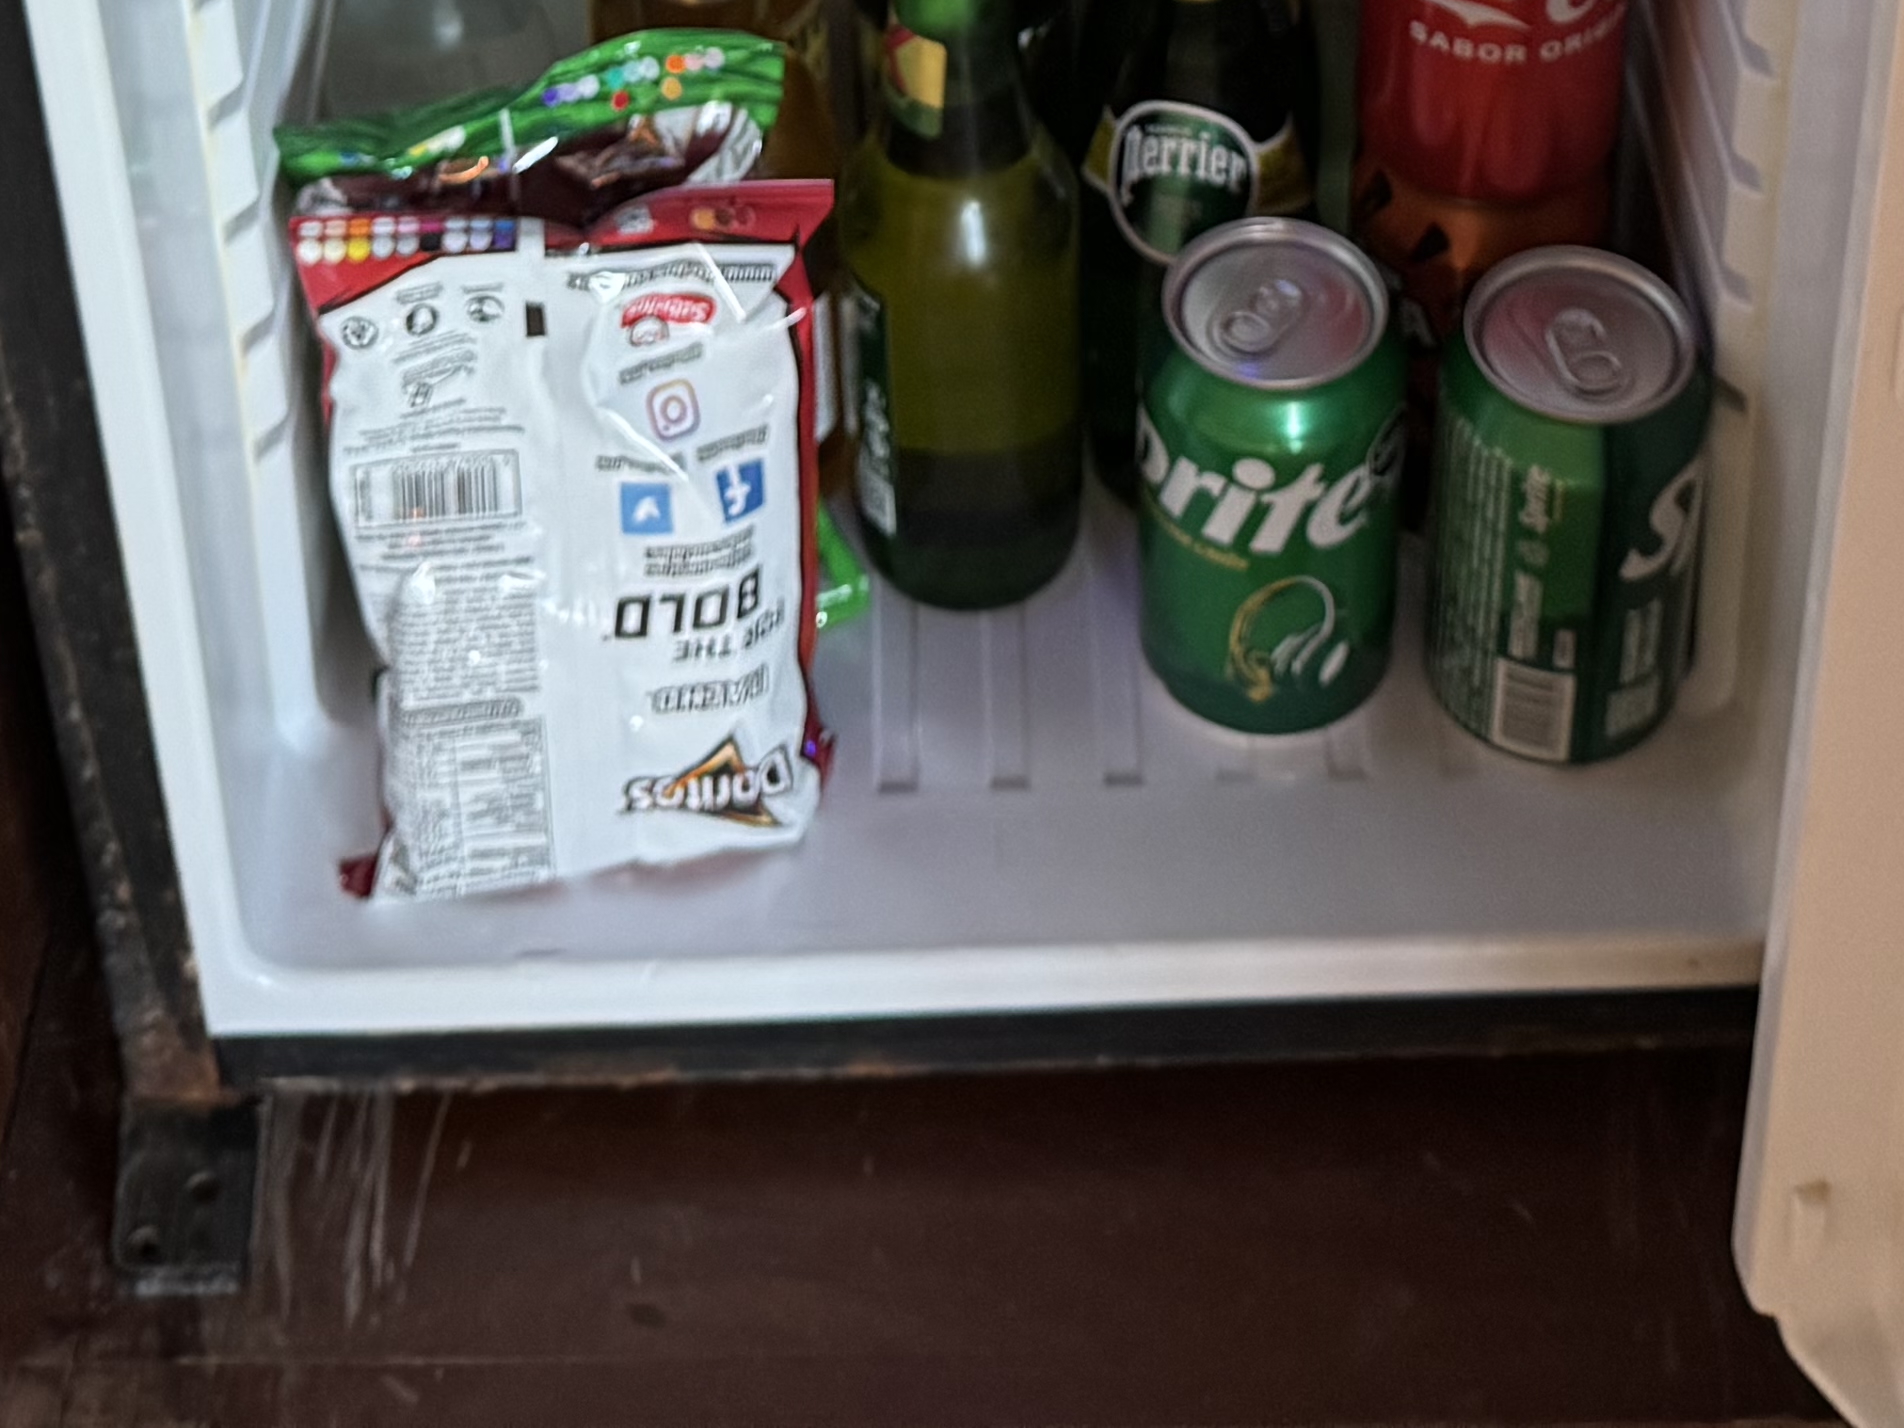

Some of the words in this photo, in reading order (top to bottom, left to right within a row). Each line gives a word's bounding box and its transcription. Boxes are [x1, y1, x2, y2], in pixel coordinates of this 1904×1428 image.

[1408, 19, 1529, 65] SABOR
[1119, 124, 1246, 207] Perrier
[614, 565, 760, 639] BOLD
[671, 633, 732, 663] THE
[624, 744, 793, 814] Doritos
